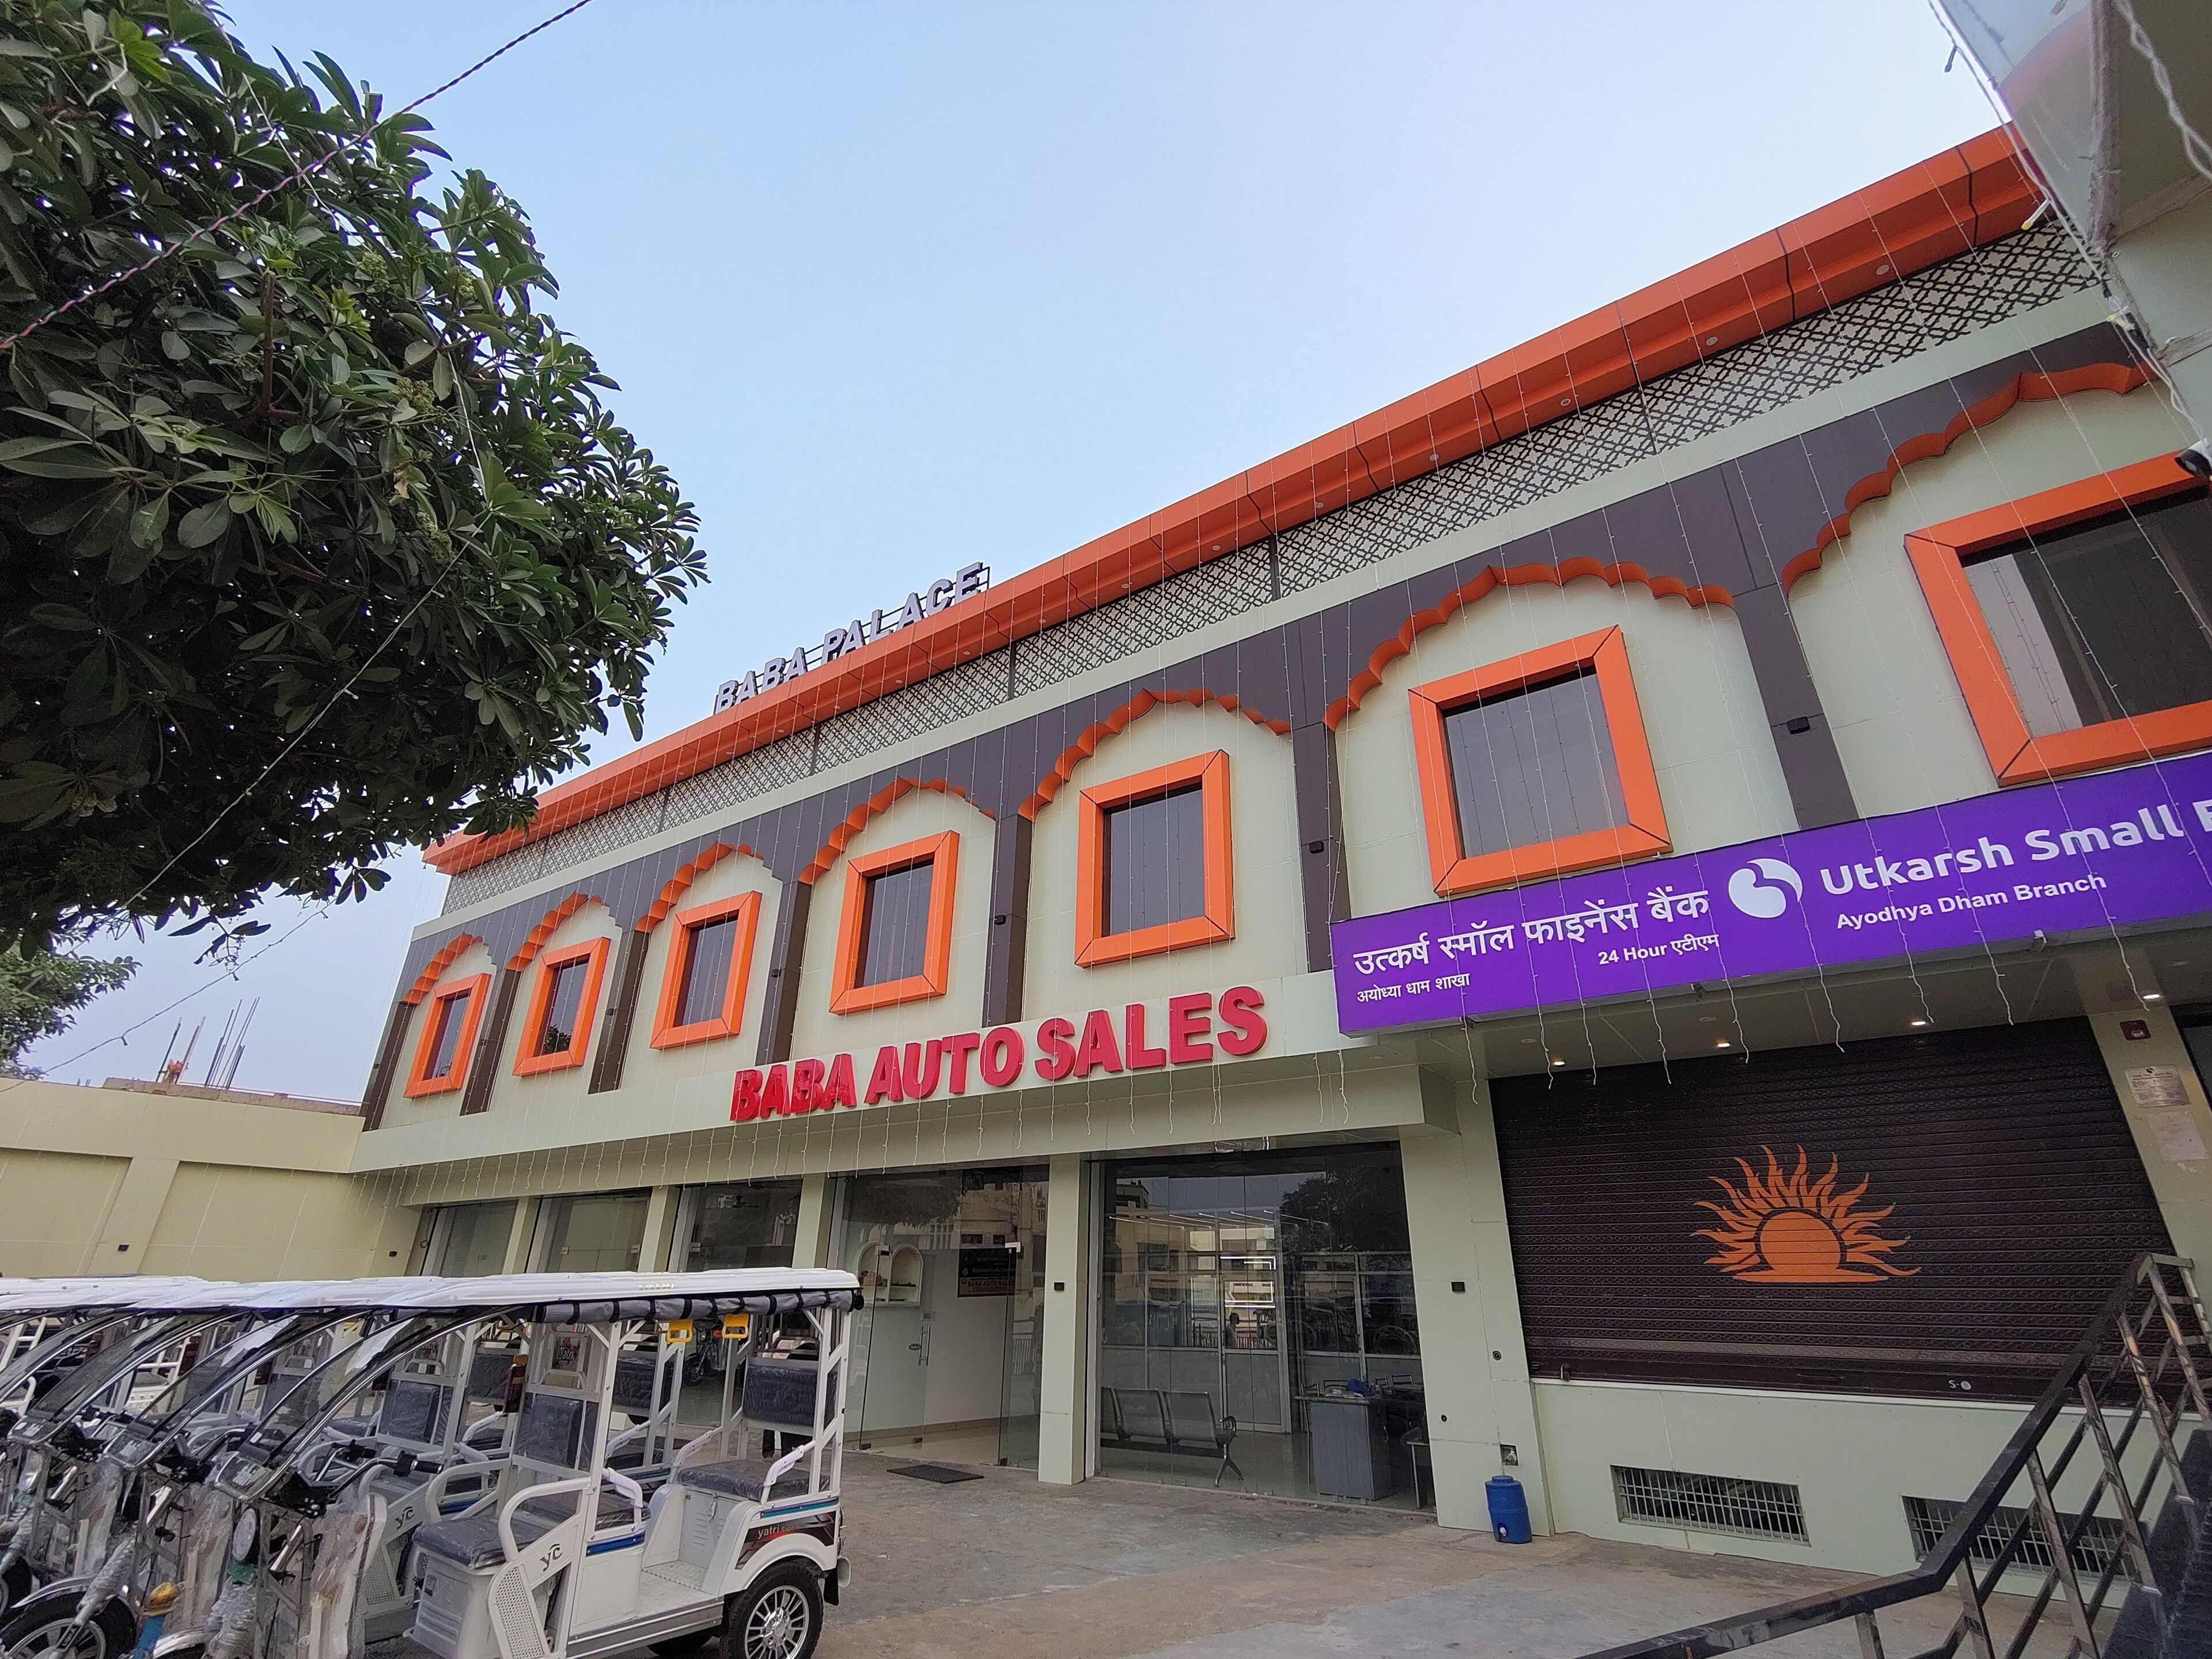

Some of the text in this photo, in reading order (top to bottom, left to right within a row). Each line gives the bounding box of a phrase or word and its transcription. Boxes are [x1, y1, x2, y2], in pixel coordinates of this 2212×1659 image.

[714, 562, 983, 715] BABA PALACE
[1820, 837, 2014, 895] Utkarsh
[2024, 804, 2184, 861] Small
[1353, 885, 1709, 975] उत्कर्ष स्मॉल फाइनेंस बैंक
[1837, 872, 2107, 930] Ayodhya Dham Branch
[1357, 973, 1470, 1002] अयोध्या धाम शाखा
[1598, 933, 1719, 965] 24 Hour एटीएम
[730, 986, 1267, 1122] BABA AUTO SALES
